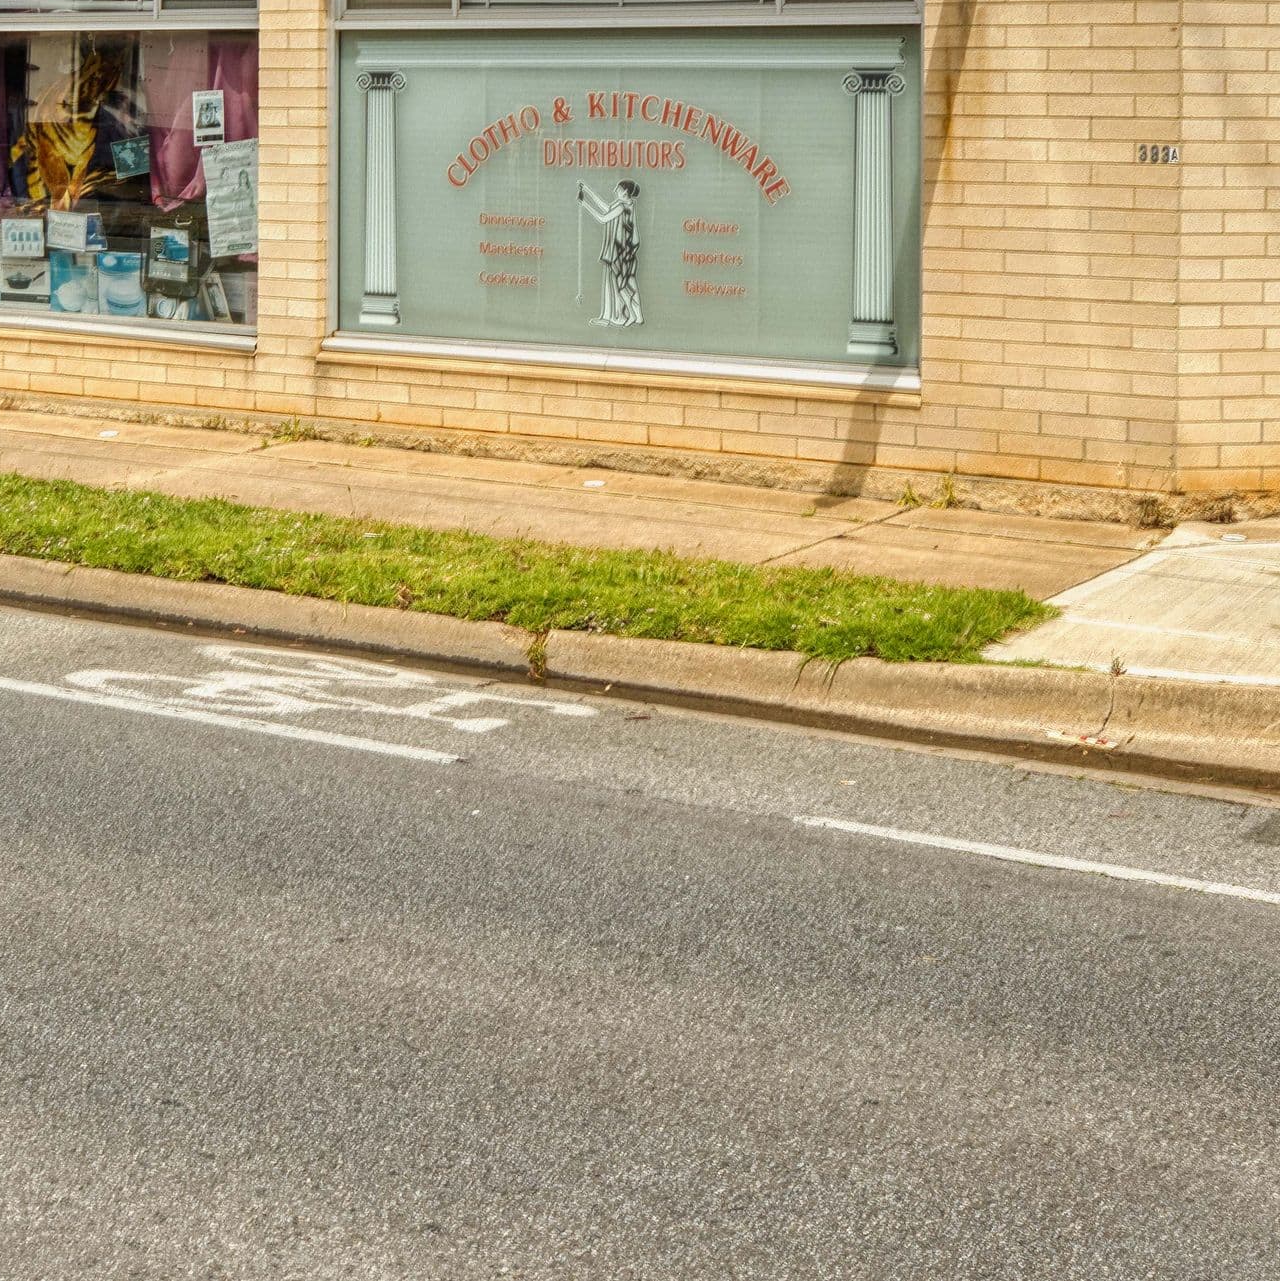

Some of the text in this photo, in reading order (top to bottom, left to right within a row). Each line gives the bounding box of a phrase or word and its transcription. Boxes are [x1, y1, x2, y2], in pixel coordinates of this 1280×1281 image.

[446, 91, 793, 207] CLOTHO & KITCHENWARE
[543, 138, 687, 170] DISTRIBUTORS
[479, 213, 546, 227] Dinnerware
[682, 217, 740, 234] Giftware
[479, 241, 545, 257] Manchester
[682, 249, 743, 266] Importers
[479, 271, 538, 286] Cookware
[682, 280, 746, 296] Tableware
